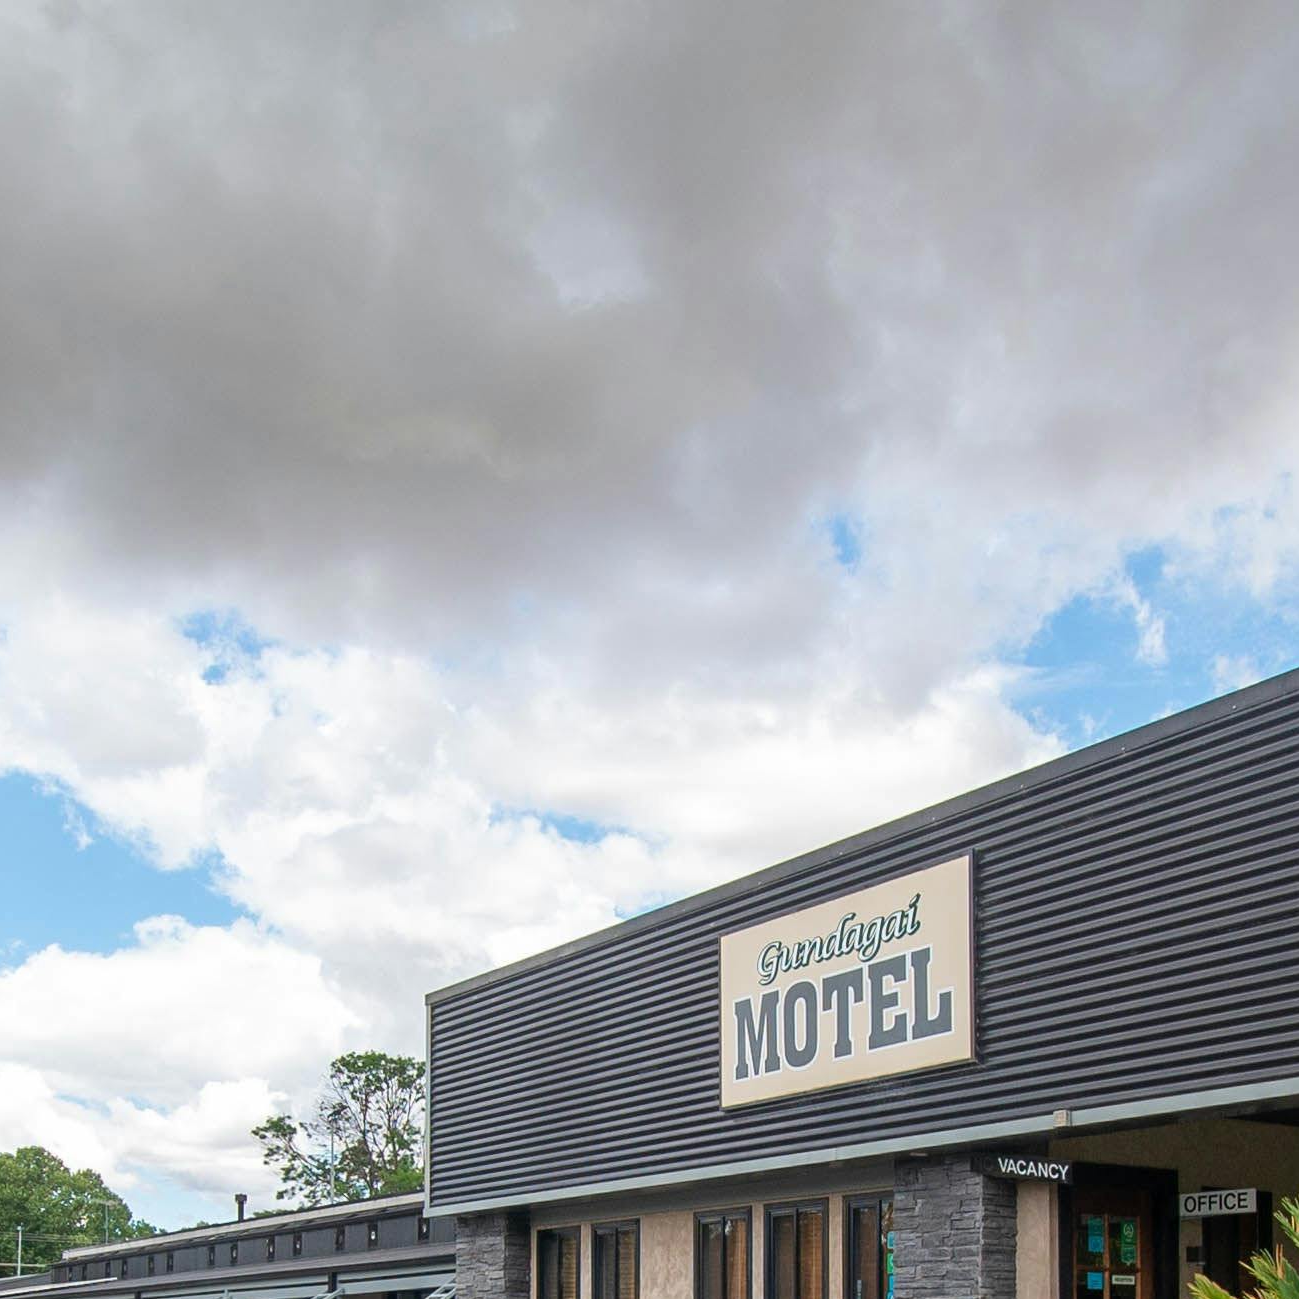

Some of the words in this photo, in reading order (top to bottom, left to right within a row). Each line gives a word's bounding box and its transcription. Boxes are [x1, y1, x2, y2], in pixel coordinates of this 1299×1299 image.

[757, 893, 921, 985] Gundagai
[734, 946, 953, 1081] MOTEL
[997, 1157, 1069, 1180] VACANCY
[1184, 1191, 1248, 1213] OFFICE
